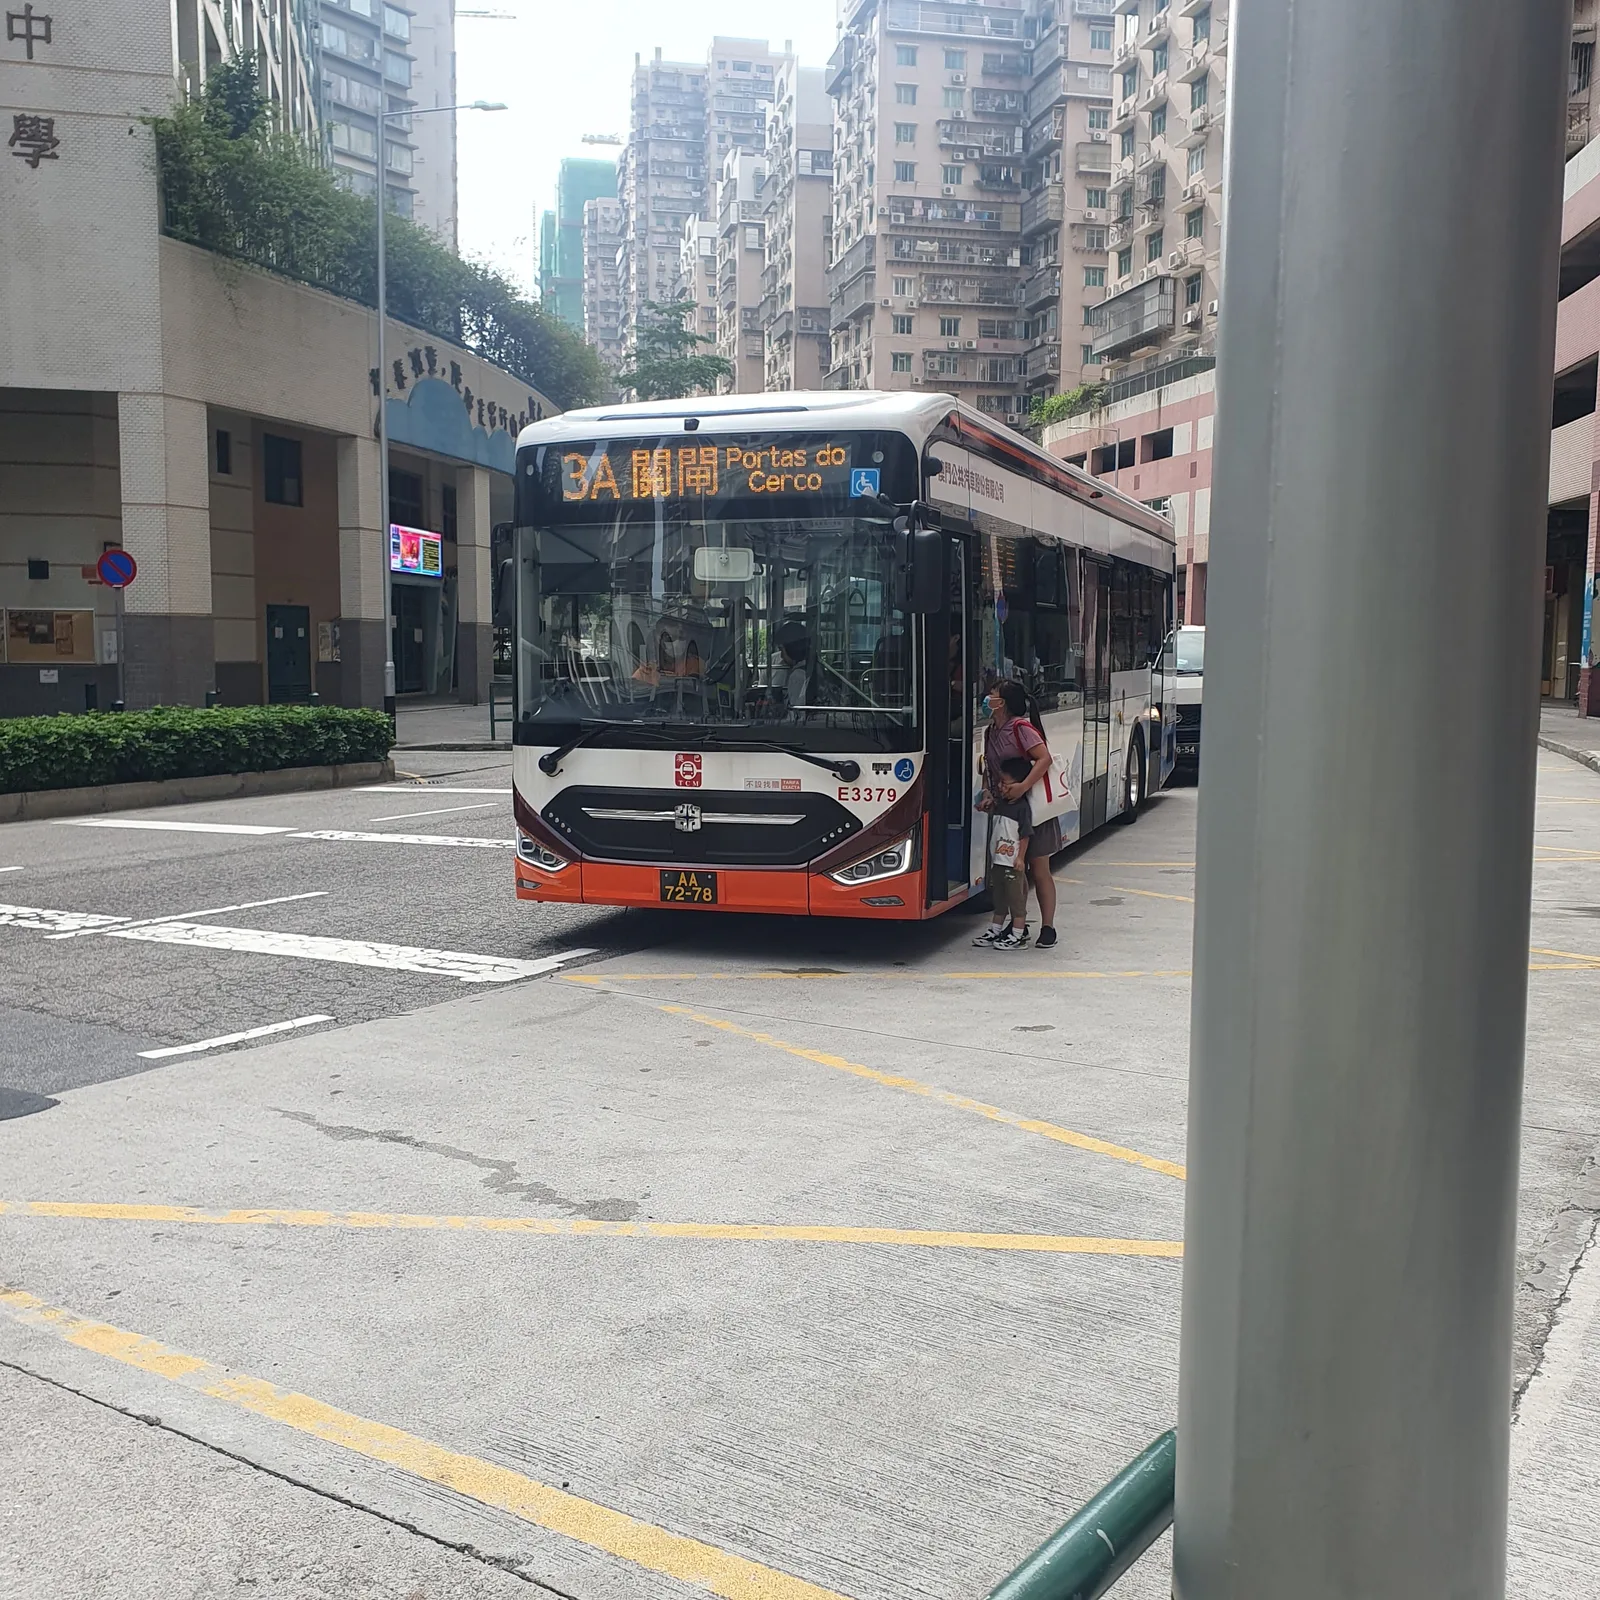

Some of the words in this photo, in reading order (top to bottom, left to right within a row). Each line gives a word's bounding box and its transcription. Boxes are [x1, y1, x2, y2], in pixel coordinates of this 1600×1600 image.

[6, 2, 61, 169] 中學
[726, 445, 807, 470] Portas
[815, 443, 846, 467] do
[563, 453, 621, 500] 3A
[632, 446, 718, 498] 關閘
[748, 470, 823, 493] Cerco
[838, 786, 897, 803] E3379
[678, 871, 698, 887] AA
[664, 885, 713, 902] 72-78
